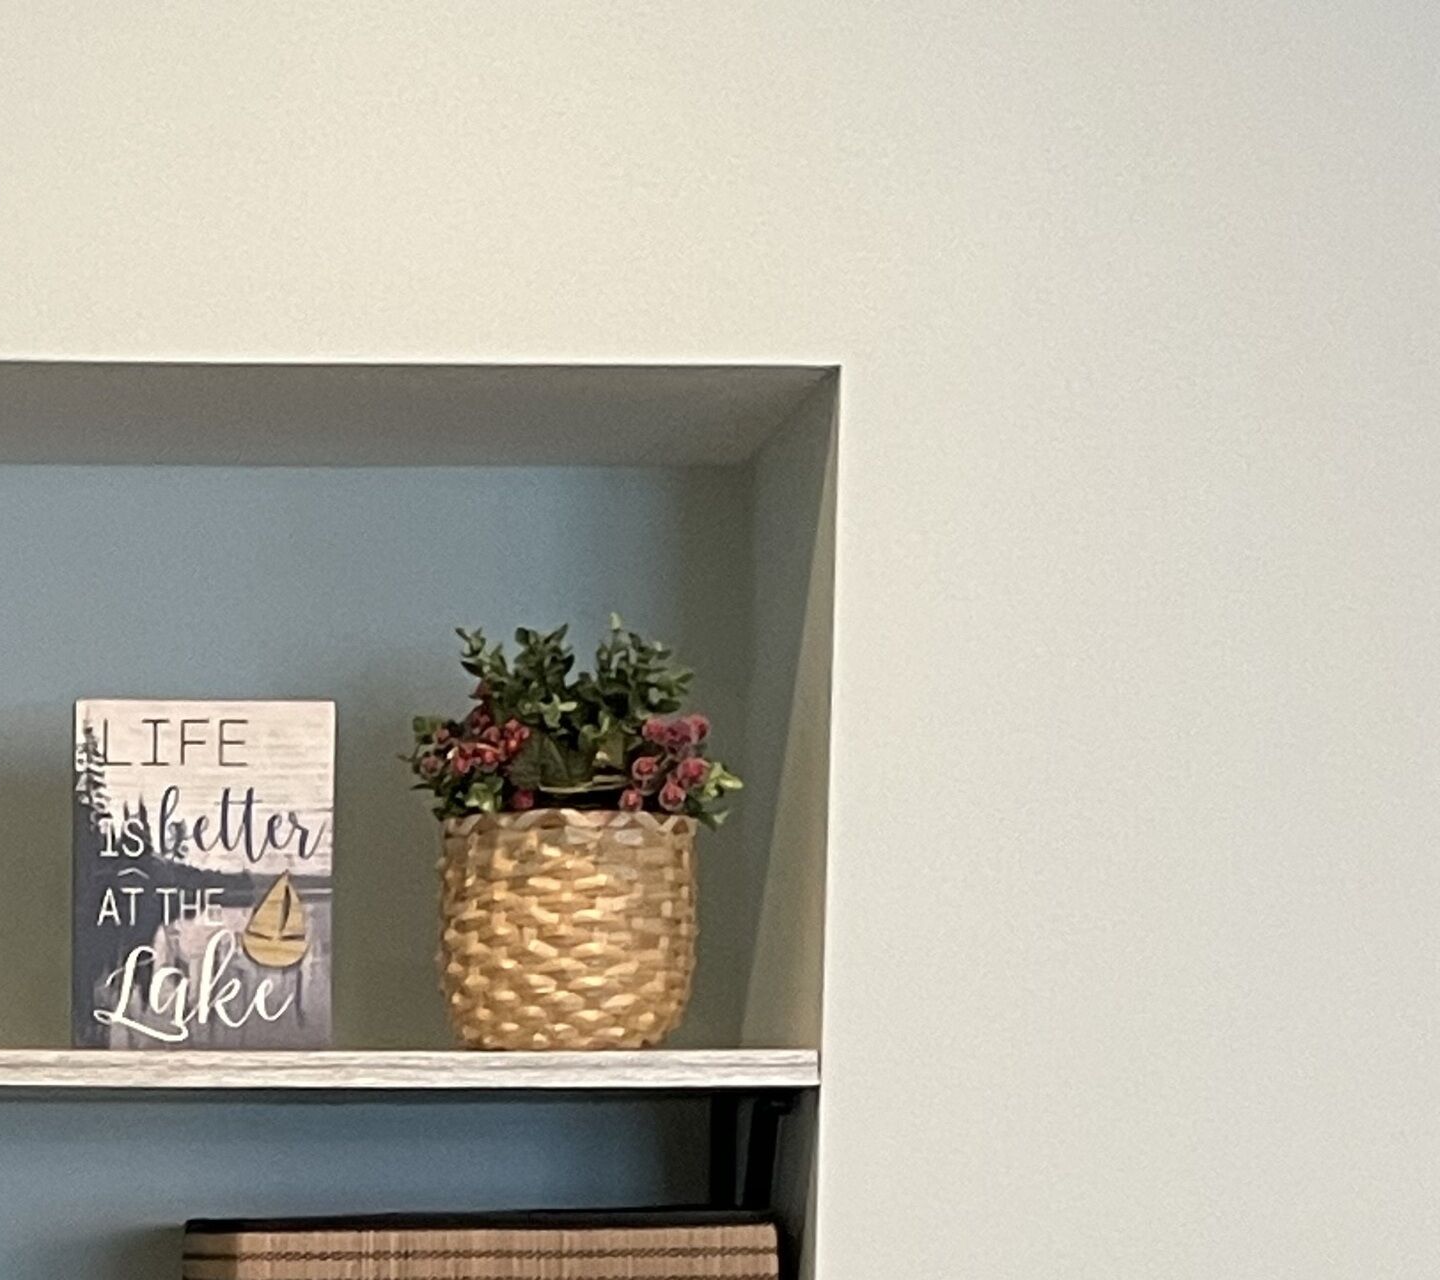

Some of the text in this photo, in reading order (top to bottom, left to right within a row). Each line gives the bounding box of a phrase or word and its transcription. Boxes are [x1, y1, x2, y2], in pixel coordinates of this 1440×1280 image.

[102, 718, 248, 766] LIFE
[99, 785, 326, 862] IS better
[97, 888, 224, 926] AT THE
[93, 930, 294, 1042] Lake
